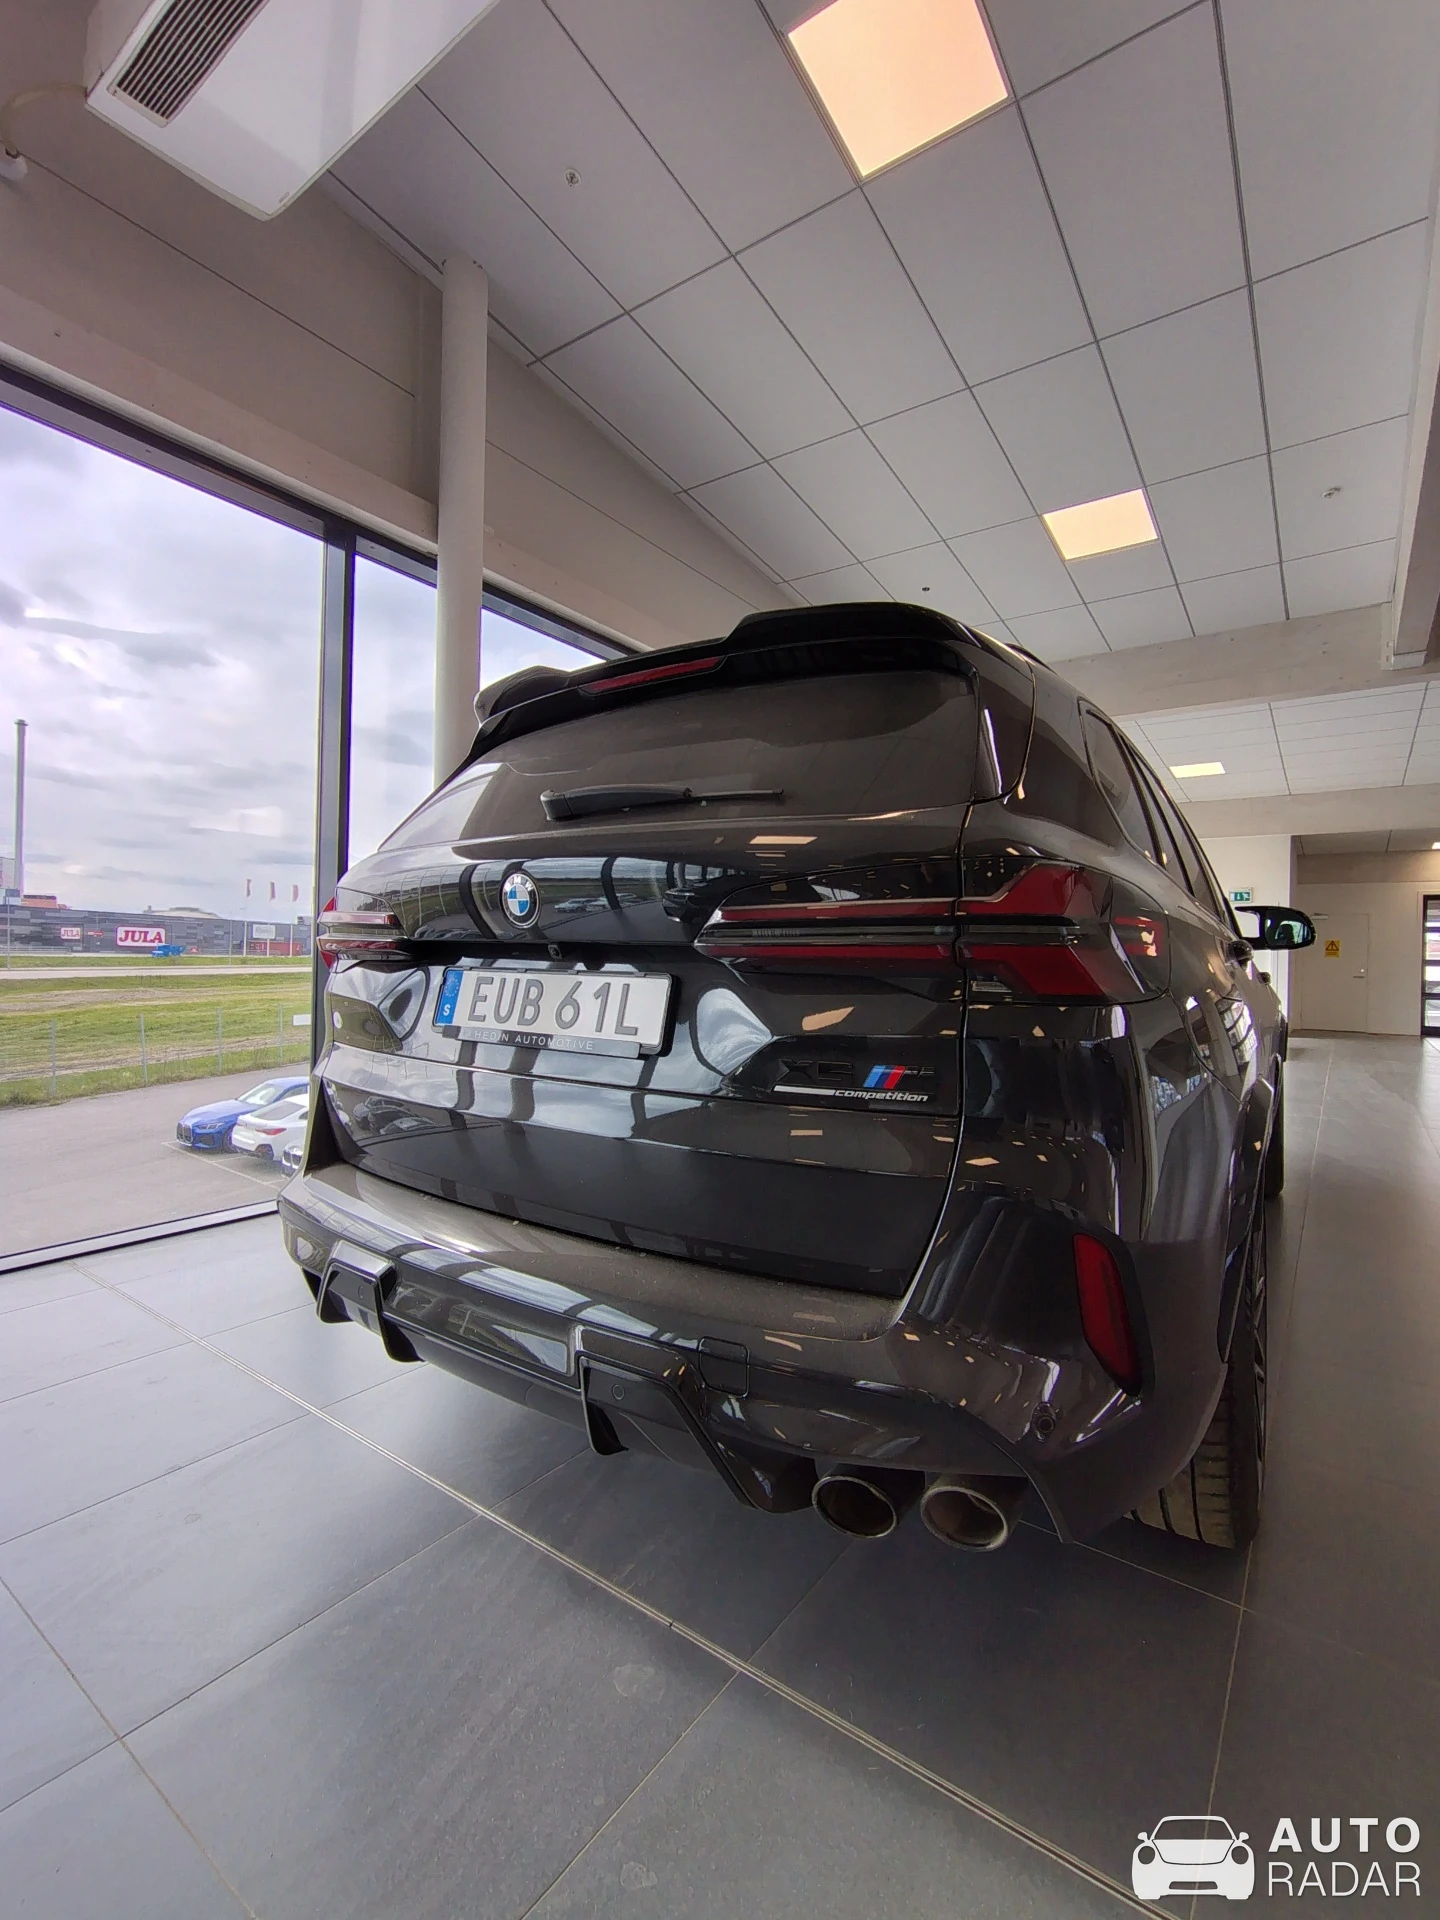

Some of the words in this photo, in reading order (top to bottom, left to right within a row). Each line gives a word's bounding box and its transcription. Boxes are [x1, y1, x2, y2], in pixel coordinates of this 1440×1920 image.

[504, 875, 534, 892] BMW
[61, 929, 80, 938] JULA
[118, 930, 163, 943] JULA
[442, 1003, 451, 1016] S
[468, 976, 544, 1026] EUB
[554, 981, 639, 1036] 61L
[473, 1030, 510, 1042] HEDIN
[514, 1036, 595, 1050] AUTOMOTIVE
[834, 1089, 929, 1102] competition
